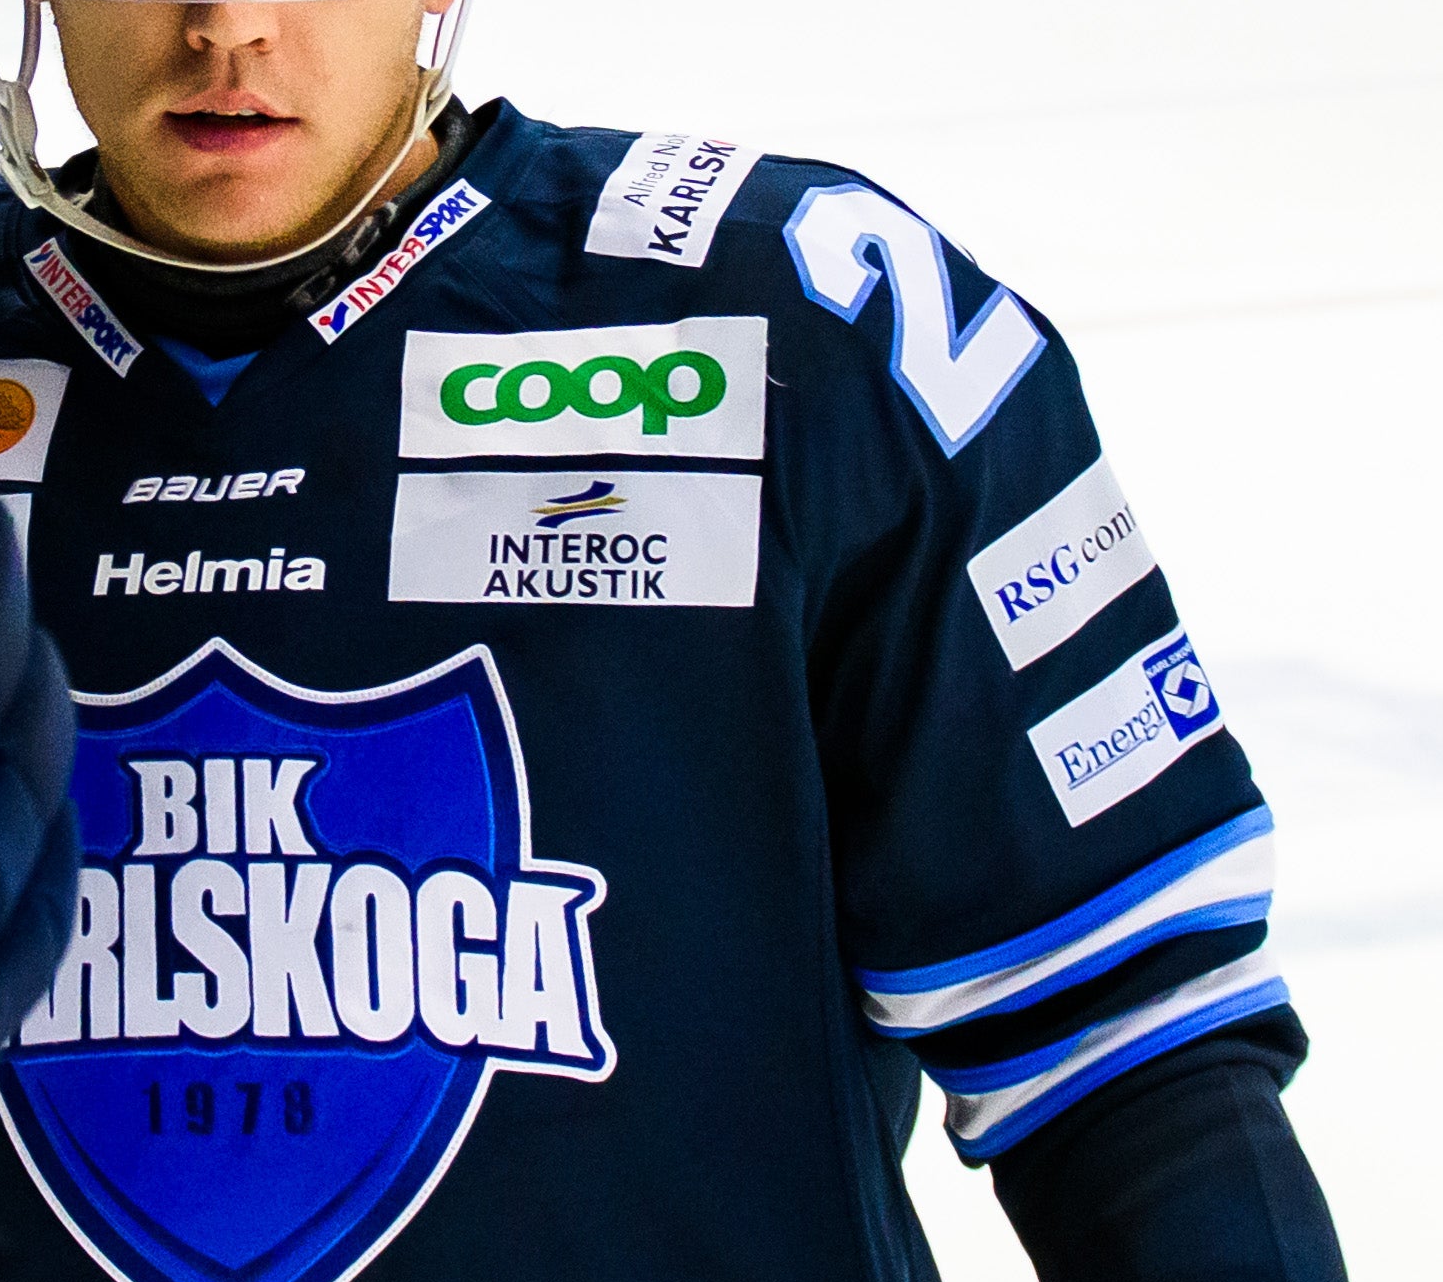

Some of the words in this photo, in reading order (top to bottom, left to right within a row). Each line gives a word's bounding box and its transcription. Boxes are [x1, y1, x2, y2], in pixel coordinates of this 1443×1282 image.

[623, 161, 671, 207] Alfred
[647, 139, 737, 256] KARLSK
[347, 188, 479, 313] INTERSPORT
[37, 254, 137, 366] INTERSPORT
[783, 181, 1048, 459] 2
[438, 349, 727, 436] coop
[122, 468, 306, 504] BAUER
[92, 547, 327, 597] Helmia
[482, 567, 666, 600] AKUSTIK
[487, 532, 668, 566] INTEROC
[993, 543, 1081, 626] RSG
[1053, 689, 1167, 786] Energi
[128, 758, 318, 856] BIK
[19, 859, 595, 1060] RLSKOGA
[146, 1081, 314, 1138] 1978
